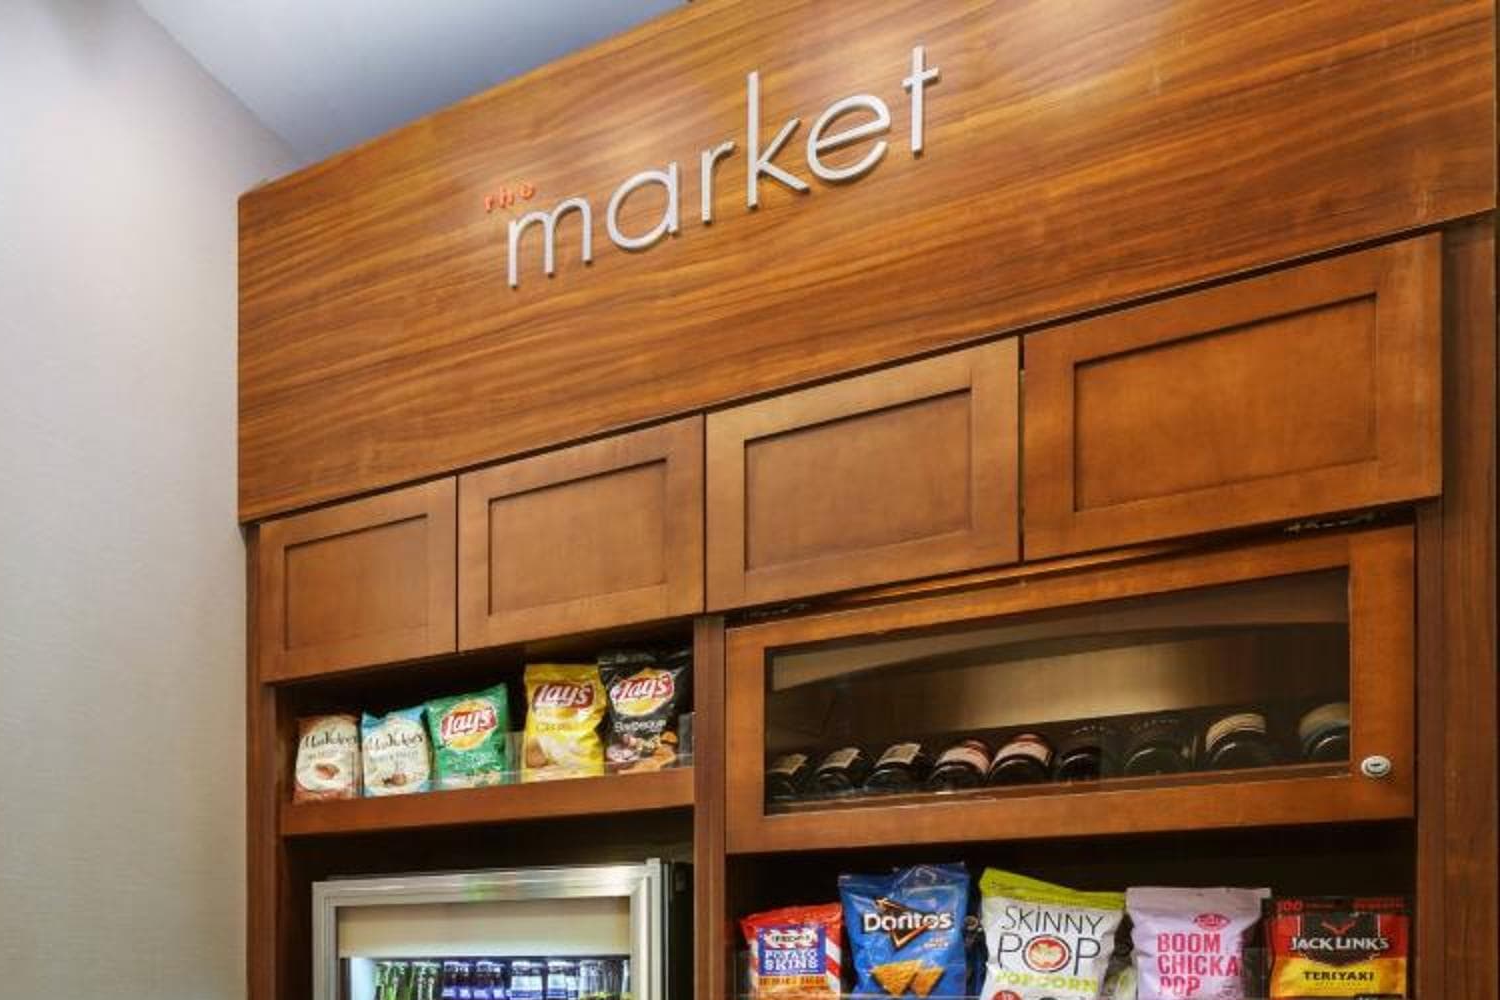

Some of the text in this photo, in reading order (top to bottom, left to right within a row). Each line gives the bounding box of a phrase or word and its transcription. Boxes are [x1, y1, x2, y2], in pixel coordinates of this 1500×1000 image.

[506, 45, 940, 288] market
[863, 910, 953, 932] Doritos
[1001, 905, 1105, 936] SKINNY
[997, 933, 1101, 975] POP
[1157, 933, 1221, 954] BOOM
[1290, 937, 1333, 951] JACK
[764, 959, 818, 971] SKINS
[1157, 954, 1239, 977] CHICKA
[1303, 971, 1375, 981] TERIYAKI
[1160, 975, 1201, 997] POP
